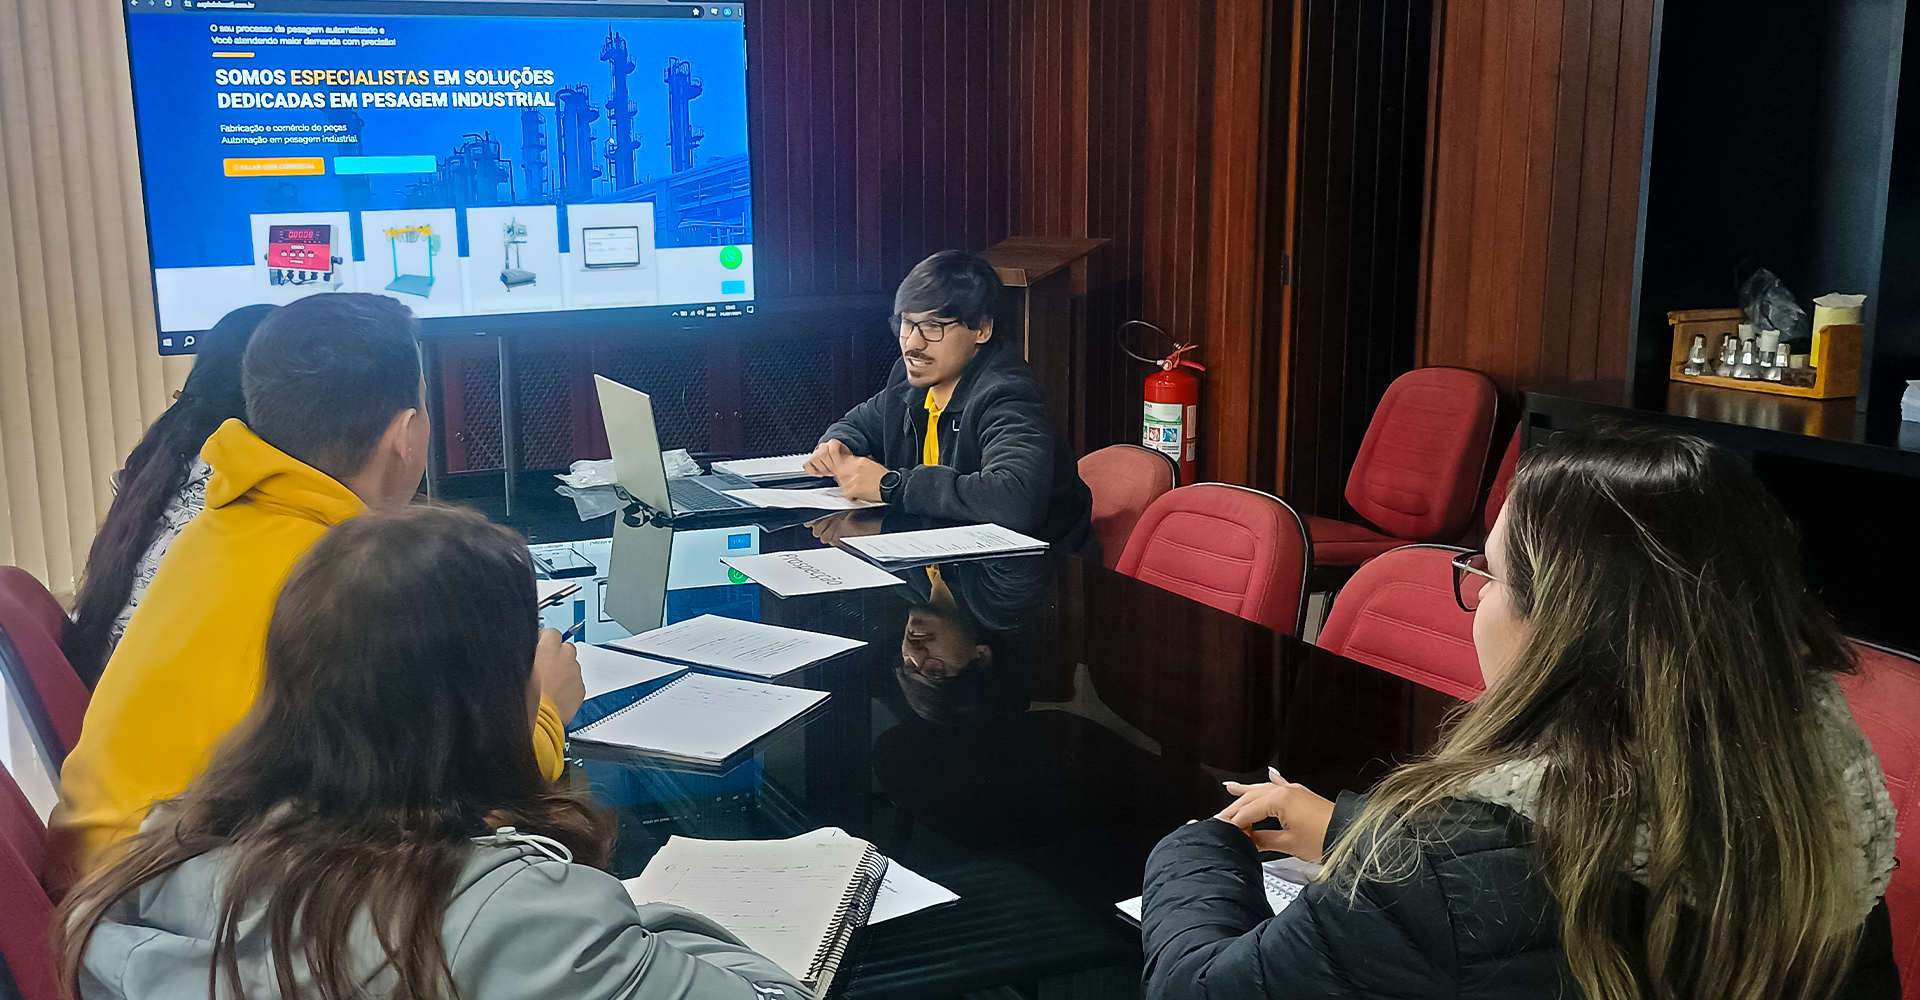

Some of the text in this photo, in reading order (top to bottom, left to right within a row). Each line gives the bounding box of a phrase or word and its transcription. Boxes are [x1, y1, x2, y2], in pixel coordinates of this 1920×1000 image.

[215, 66, 554, 89] SOMOS ESPECIALISTAS EM SOLUÇÕES
[217, 91, 556, 109] DEDICADAS EM PESAGEM INDUSTRIAL
[220, 123, 264, 133] Fabricação
[273, 123, 309, 132] comércio
[323, 125, 347, 133] peças
[221, 136, 268, 145] Automação
[284, 136, 320, 145] pesagem
[322, 134, 358, 143] industrial
[778, 554, 843, 586] Prospecção
